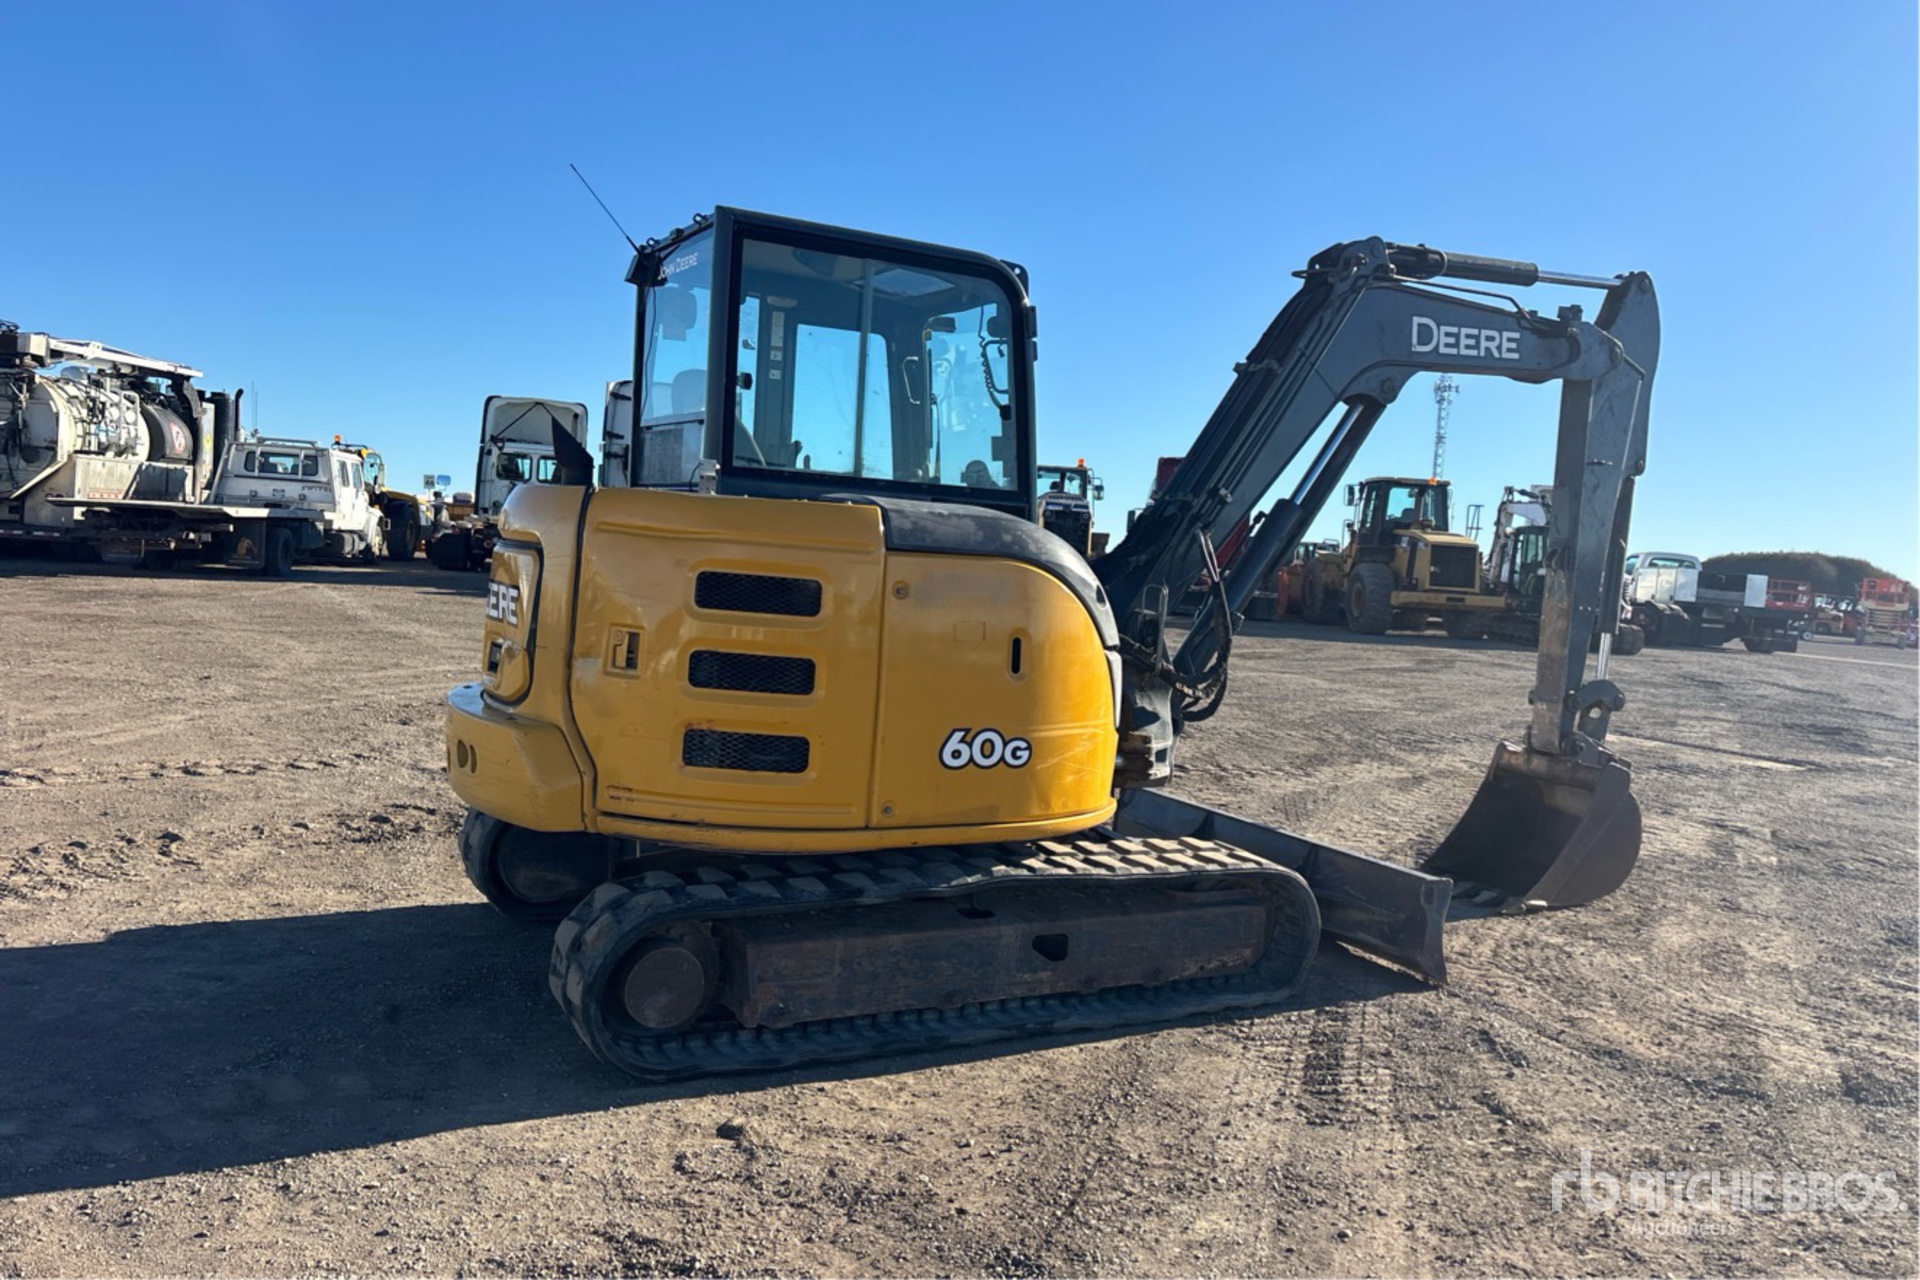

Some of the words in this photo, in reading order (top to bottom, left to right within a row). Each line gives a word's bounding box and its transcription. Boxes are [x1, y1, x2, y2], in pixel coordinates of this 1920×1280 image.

[676, 252, 698, 273] DEERE
[1411, 315, 1521, 359] DEERE
[939, 728, 1032, 770] 60G
